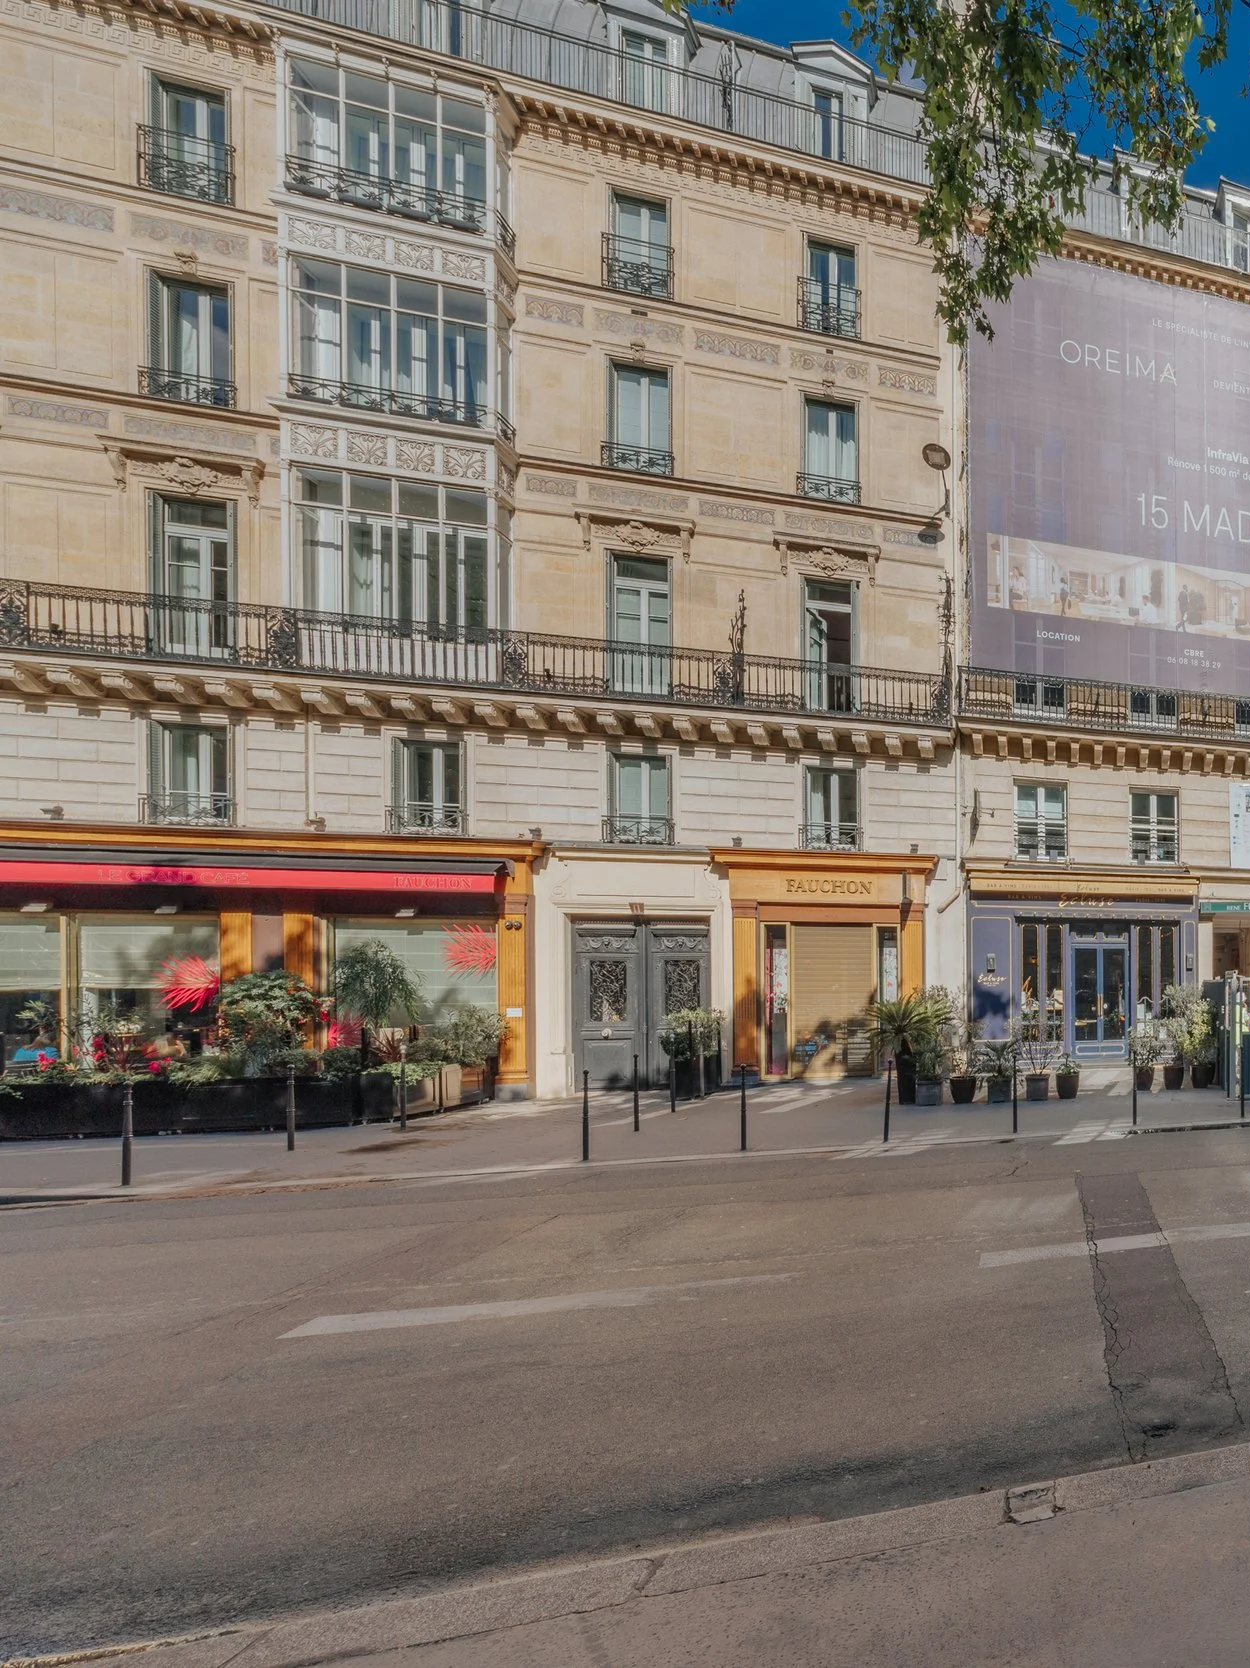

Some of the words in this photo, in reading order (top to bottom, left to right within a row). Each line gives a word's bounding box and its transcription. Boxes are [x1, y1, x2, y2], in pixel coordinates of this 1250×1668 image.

[1152, 318, 1162, 328] LE
[1165, 320, 1218, 341] SPÉCIALISTE
[1221, 334, 1232, 345] DE
[1060, 339, 1178, 387] OREIMA
[1213, 379, 1250, 394] DEVIENT
[1207, 447, 1249, 465] InfraVia
[1167, 456, 1201, 472] Rénove
[1209, 465, 1227, 476] 500
[1137, 492, 1169, 529] 15
[1036, 629, 1081, 643] LOCATION
[1184, 648, 1205, 658] CBRE
[1167, 655, 1177, 664] 06
[1212, 661, 1221, 669] 29
[200, 871, 249, 884] CAFÉ
[394, 876, 472, 889] FAUCHON
[785, 879, 873, 894] FAUCHON
